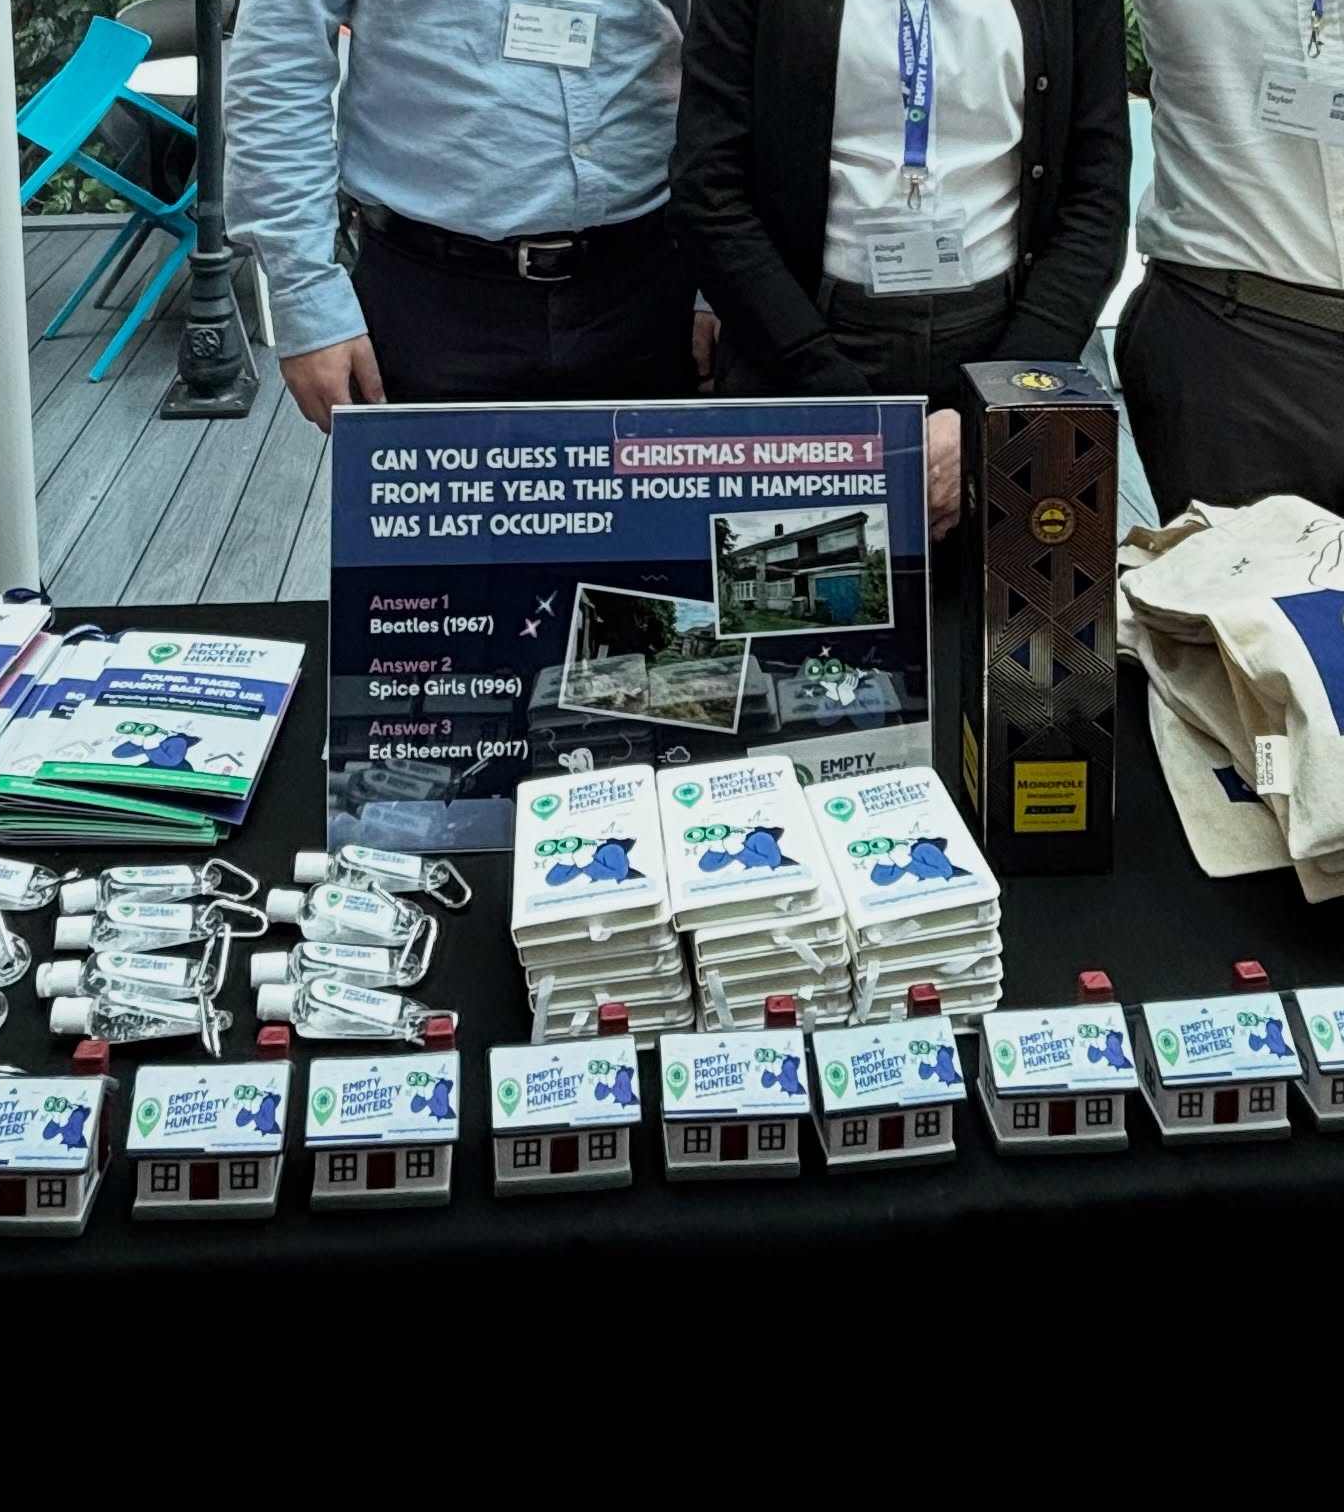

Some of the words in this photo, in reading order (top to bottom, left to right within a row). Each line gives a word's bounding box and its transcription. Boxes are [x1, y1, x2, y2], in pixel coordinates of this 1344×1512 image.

[372, 450, 417, 470] CAN
[426, 449, 477, 469] YOU
[487, 447, 556, 468] GUESS
[565, 446, 609, 467] THE
[621, 444, 745, 466] CHRISTMAS
[754, 442, 853, 464] NUMBER
[863, 442, 872, 462] 1
[372, 482, 439, 504] FROM
[448, 481, 494, 502] THE
[502, 480, 565, 501] YEAR
[573, 479, 623, 500] THIS
[632, 477, 710, 499] HOUSE
[719, 477, 742, 497] IN
[752, 475, 886, 496] HAMPSHIRE
[371, 516, 420, 537] WAS
[429, 515, 482, 536] LAST
[490, 512, 613, 535] OCCUPIED?
[370, 596, 438, 610] Answer
[442, 595, 448, 608] 1
[371, 618, 438, 633] Beatles
[444, 616, 493, 635] (1967)
[369, 658, 437, 673] Answer
[442, 657, 451, 671] 2
[369, 680, 419, 700] Spice
[424, 679, 466, 695] Girls
[471, 678, 521, 698] (1996)
[369, 721, 437, 736] Answer
[442, 719, 451, 734] 3
[369, 744, 391, 759] Ed
[396, 743, 472, 759] Sheeran
[476, 740, 528, 760] (2017)
[820, 752, 876, 775] EMPTY
[694, 1053, 729, 1068] EMPTY
[695, 1062, 751, 1080] PROPERTY
